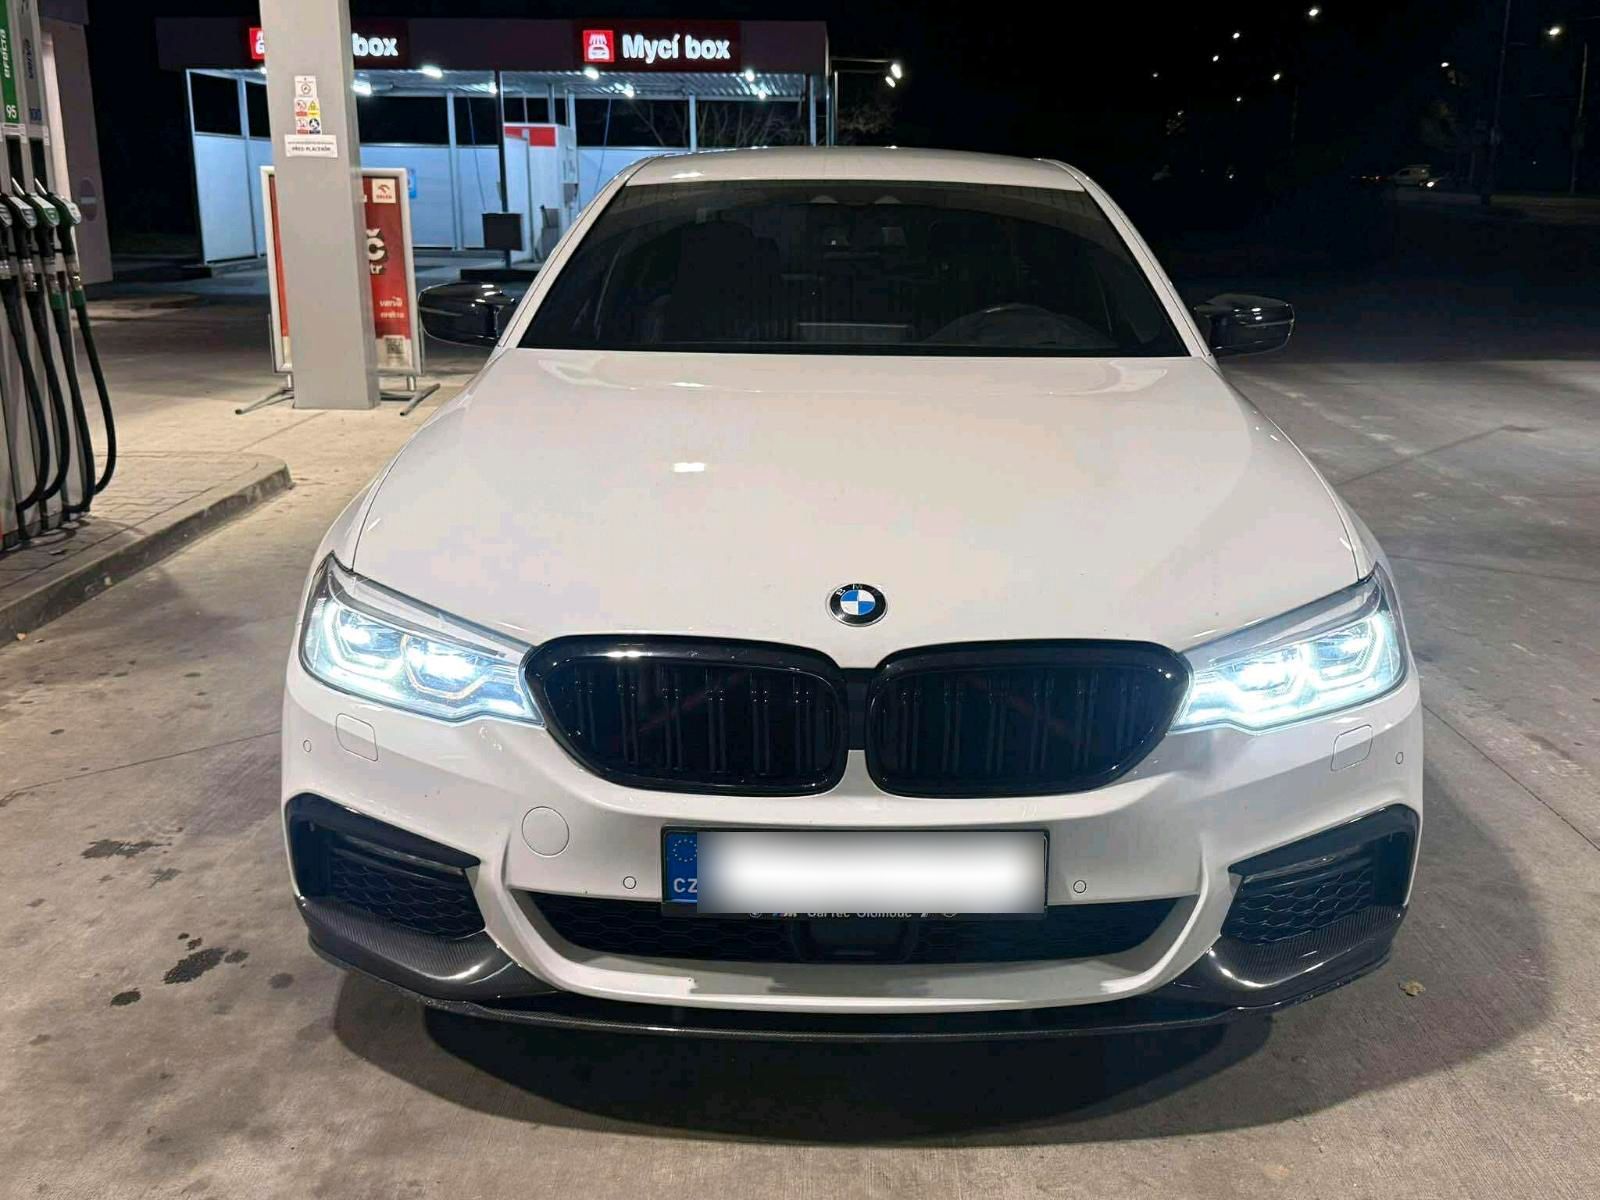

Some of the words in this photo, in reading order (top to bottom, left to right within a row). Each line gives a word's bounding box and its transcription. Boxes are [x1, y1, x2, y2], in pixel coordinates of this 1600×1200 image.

[352, 32, 399, 57] box
[622, 33, 681, 64] Mycí
[685, 34, 731, 60] box
[6, 104, 17, 119] 95
[673, 877, 698, 893] CZ
